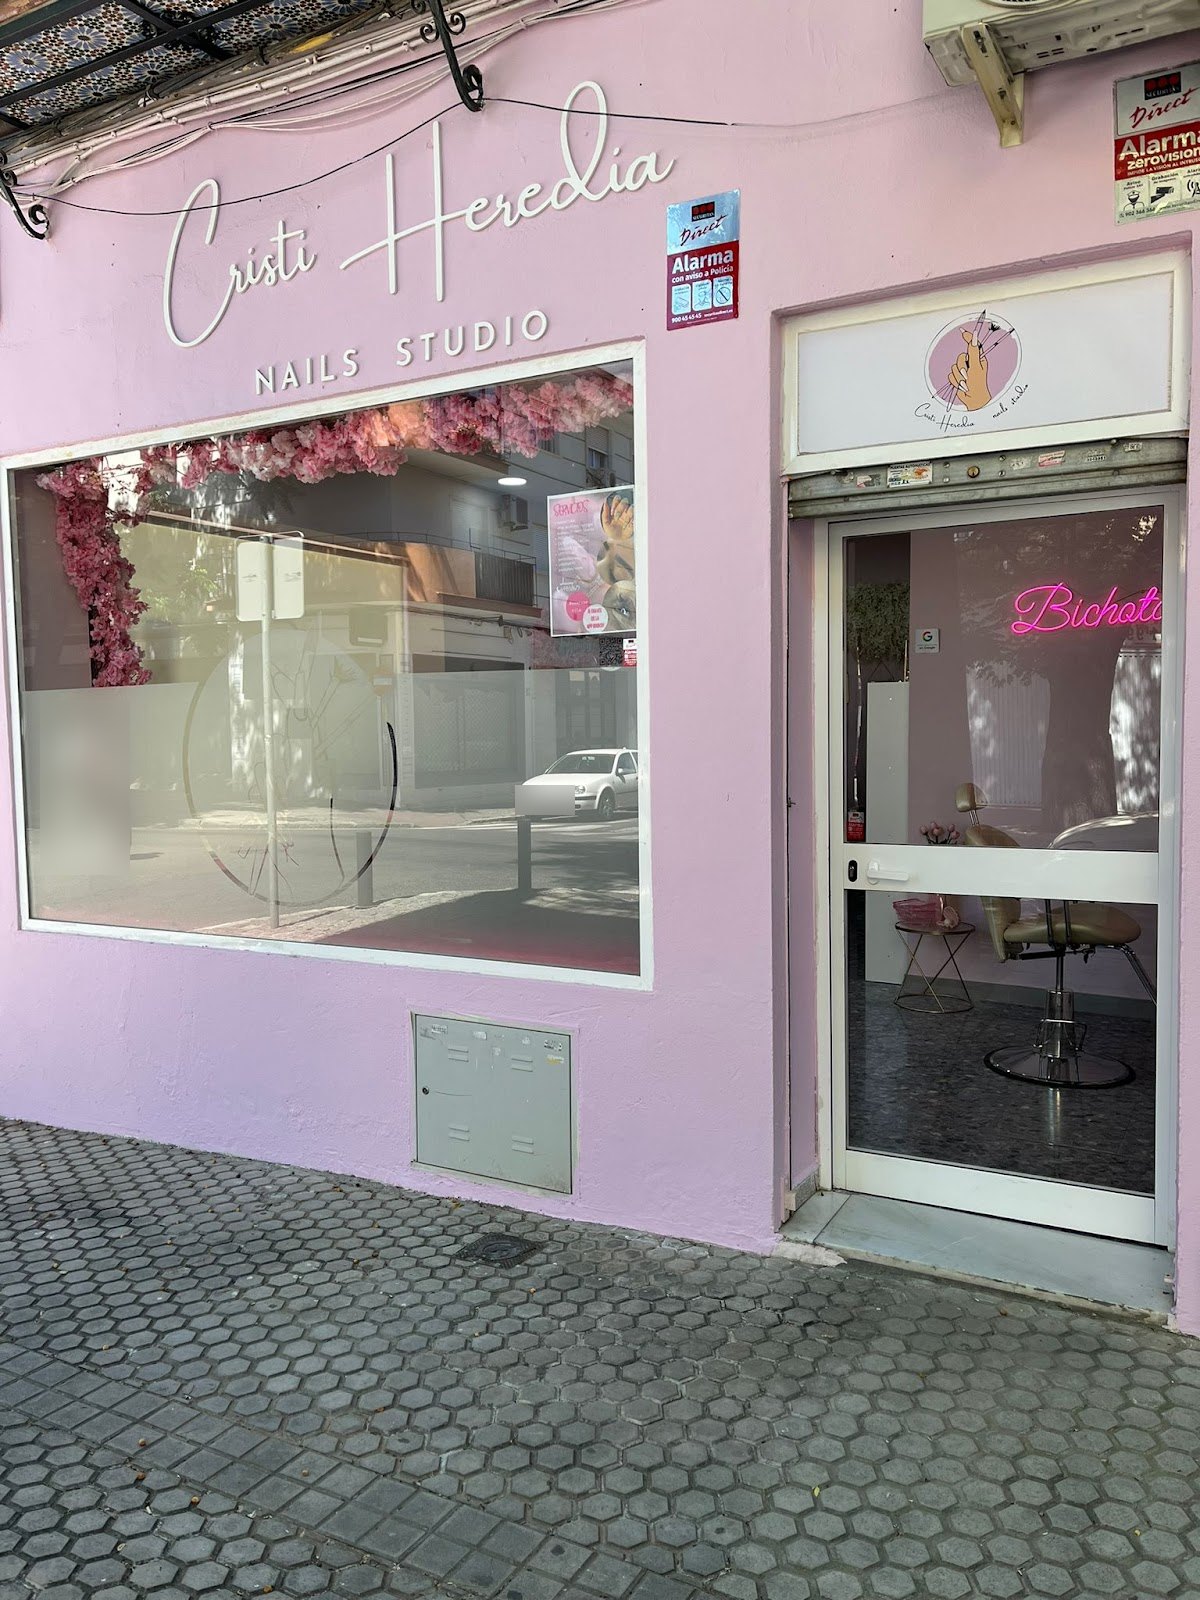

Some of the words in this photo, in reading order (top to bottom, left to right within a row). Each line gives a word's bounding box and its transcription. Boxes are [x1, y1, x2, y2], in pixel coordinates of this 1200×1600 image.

[1129, 87, 1200, 129] Direct
[1119, 131, 1200, 160] Alarm
[163, 178, 317, 348] Cristi
[339, 80, 676, 302] Heredia
[680, 214, 728, 247] Direct
[672, 249, 733, 275] Alarma
[672, 276, 684, 284] con
[685, 271, 703, 281] aviso
[711, 264, 733, 276] Policía
[256, 348, 360, 395] NAILS
[395, 309, 549, 368] STUDIO
[914, 402, 936, 422] Cristi
[936, 414, 975, 433] Heredia
[992, 402, 1008, 419] nails
[1011, 383, 1029, 406] studio
